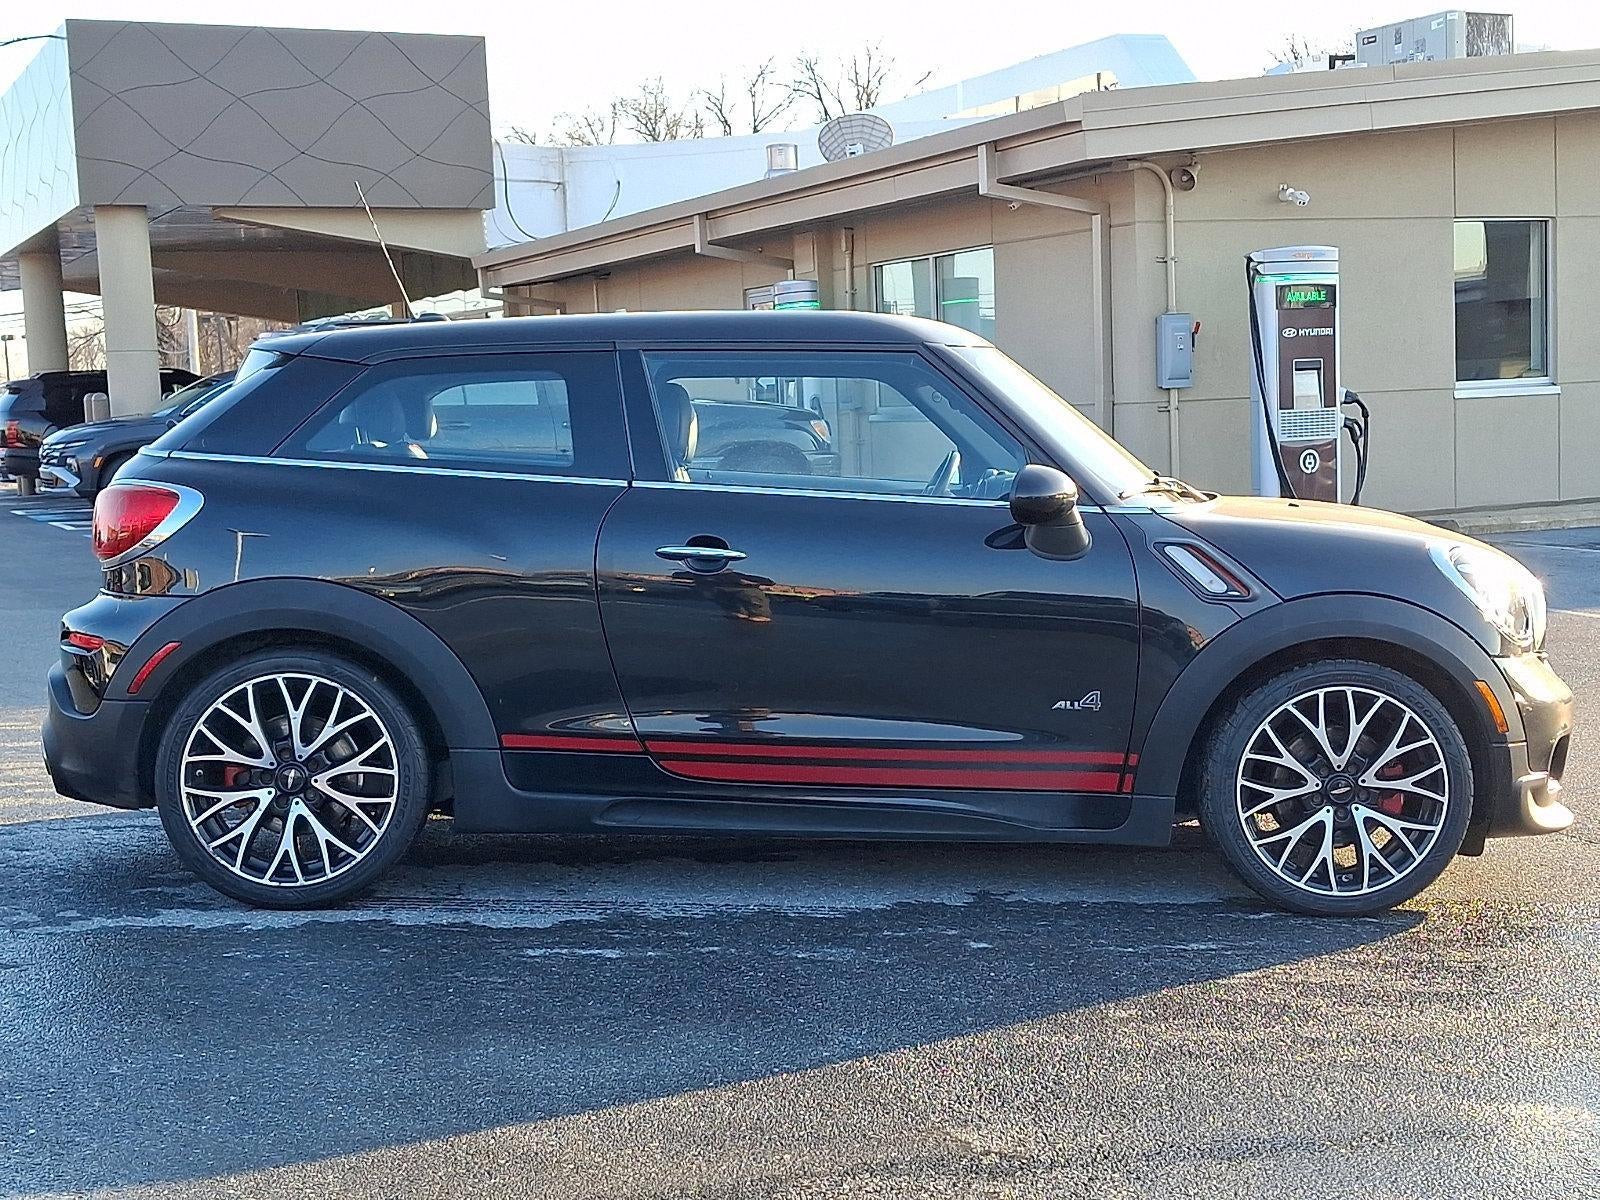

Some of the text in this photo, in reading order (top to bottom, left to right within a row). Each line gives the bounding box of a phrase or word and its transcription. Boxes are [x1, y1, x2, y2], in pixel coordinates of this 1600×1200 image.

[1286, 290, 1327, 302] AVAILABLE
[1299, 328, 1333, 336] HYUNDAI
[1406, 695, 1452, 746] COOPER
[394, 764, 411, 830] COOPER
